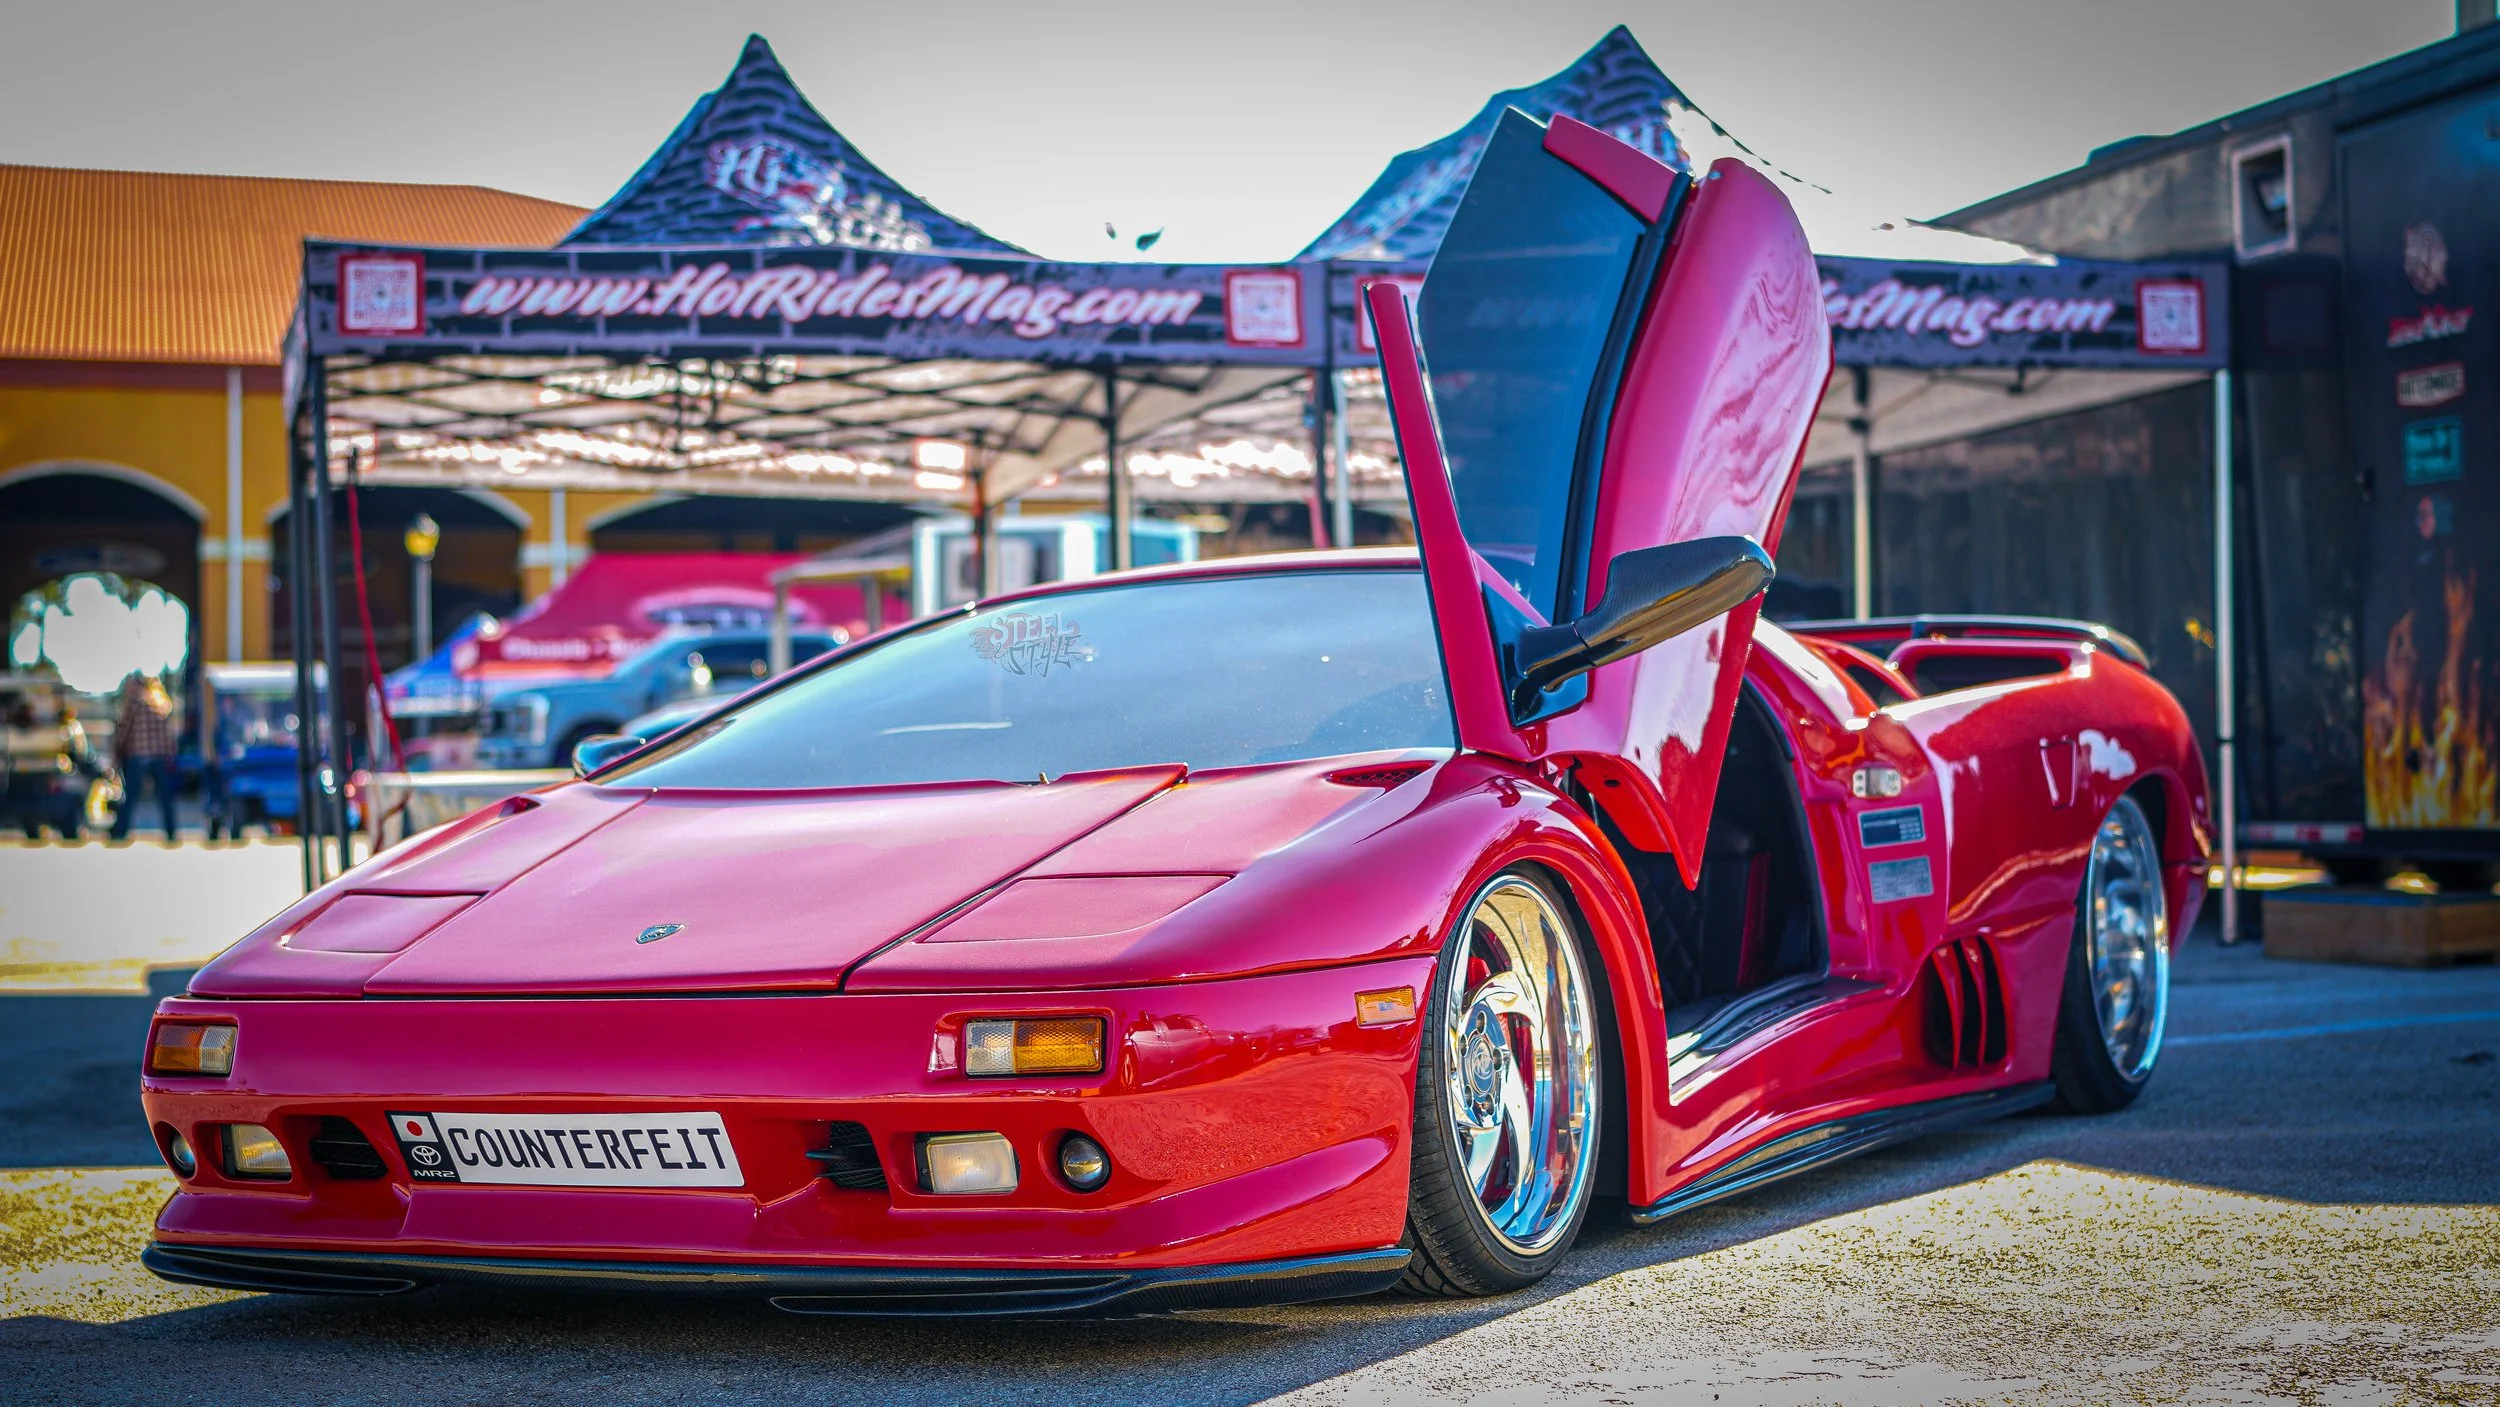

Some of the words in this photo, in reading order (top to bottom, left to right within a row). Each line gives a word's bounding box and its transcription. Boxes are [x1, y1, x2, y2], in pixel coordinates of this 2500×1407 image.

[461, 262, 1202, 338] www.HotRidesMag.com
[990, 611, 1072, 646] STEEL
[1009, 634, 1081, 678] STYLE
[447, 1127, 727, 1169] COUNTERFEIT
[413, 1169, 456, 1178] MR2
